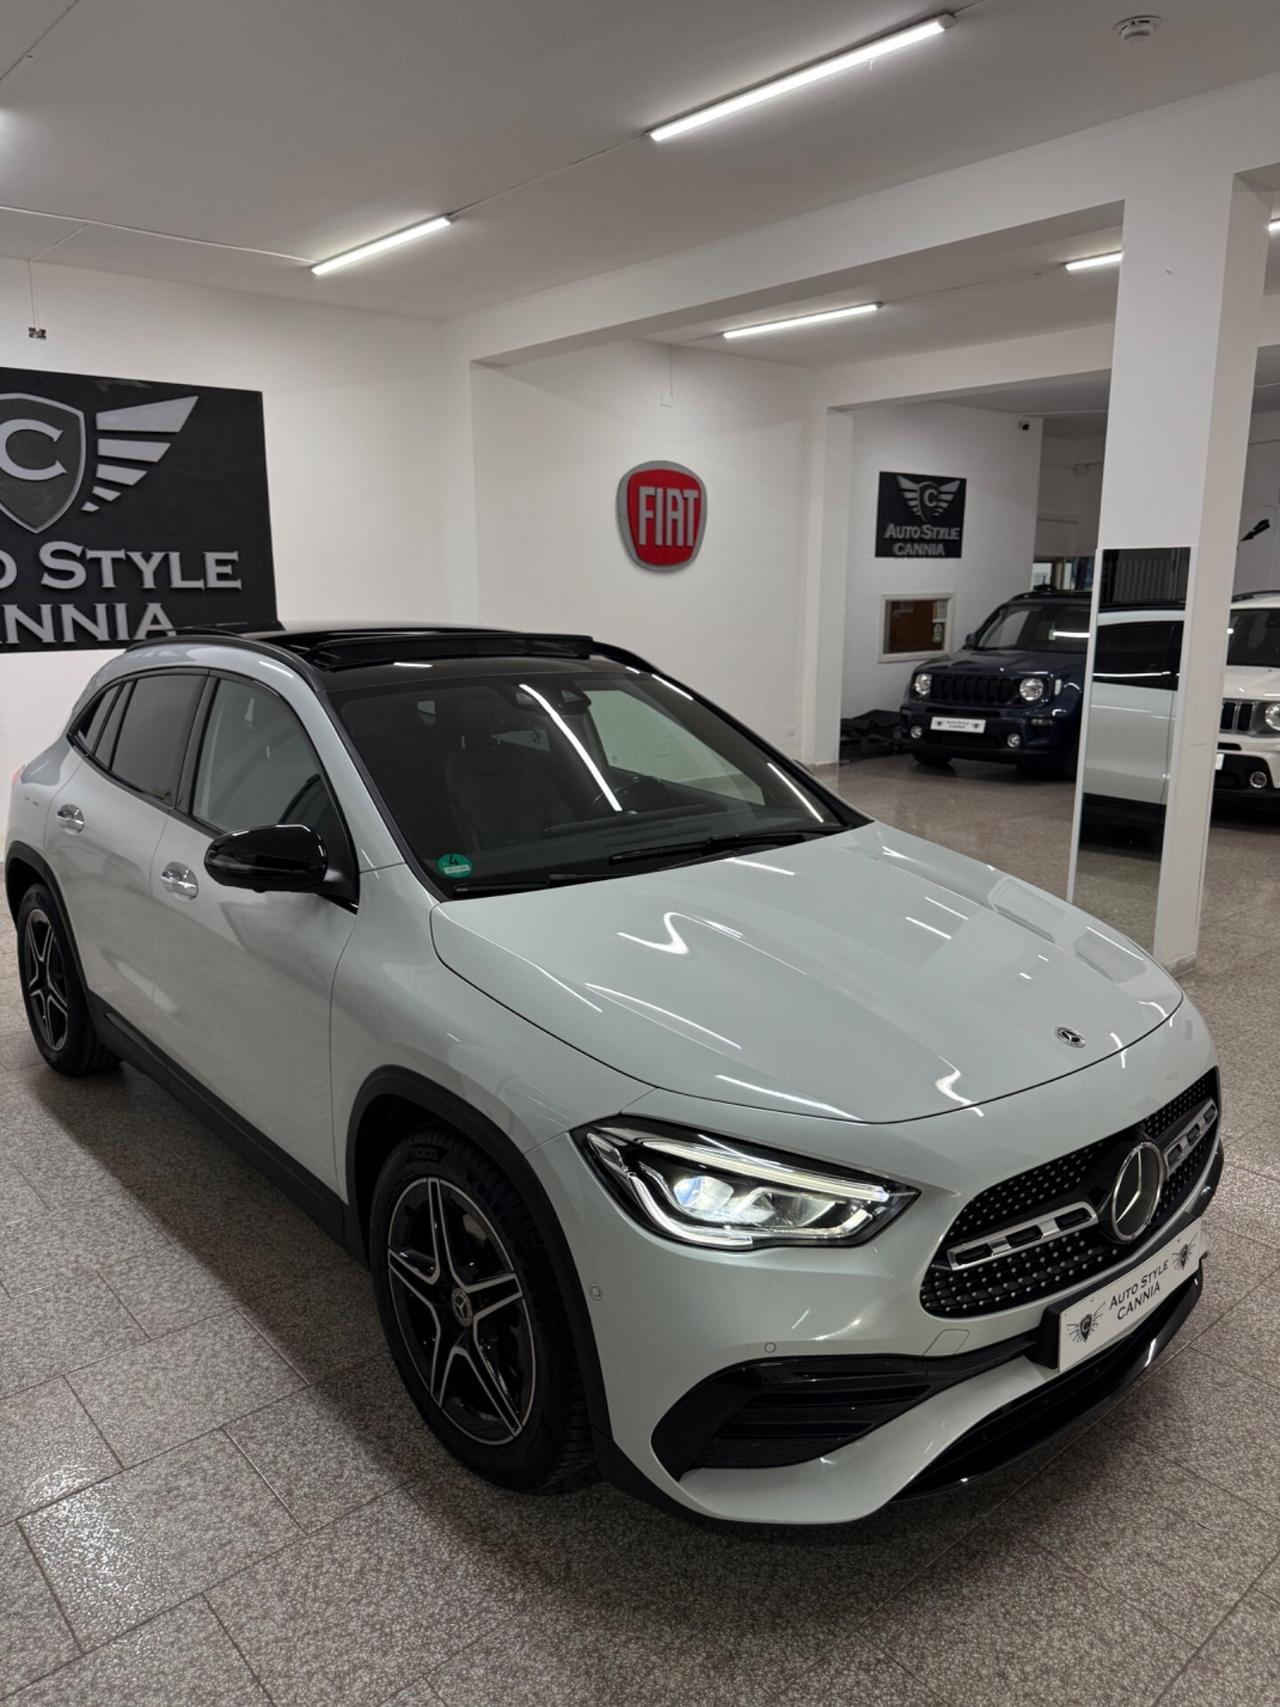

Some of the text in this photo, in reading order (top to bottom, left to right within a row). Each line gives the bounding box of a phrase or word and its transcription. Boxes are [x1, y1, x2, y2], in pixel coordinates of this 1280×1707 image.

[638, 485, 699, 547] FIAT
[883, 522, 960, 540] AUTO STYLE
[39, 540, 242, 591] STYLE
[893, 541, 945, 556] CANNIA
[0, 602, 177, 645] NNIA
[1110, 1259, 1169, 1311] AUTO STYLE
[1117, 1280, 1161, 1320] CANNIA
